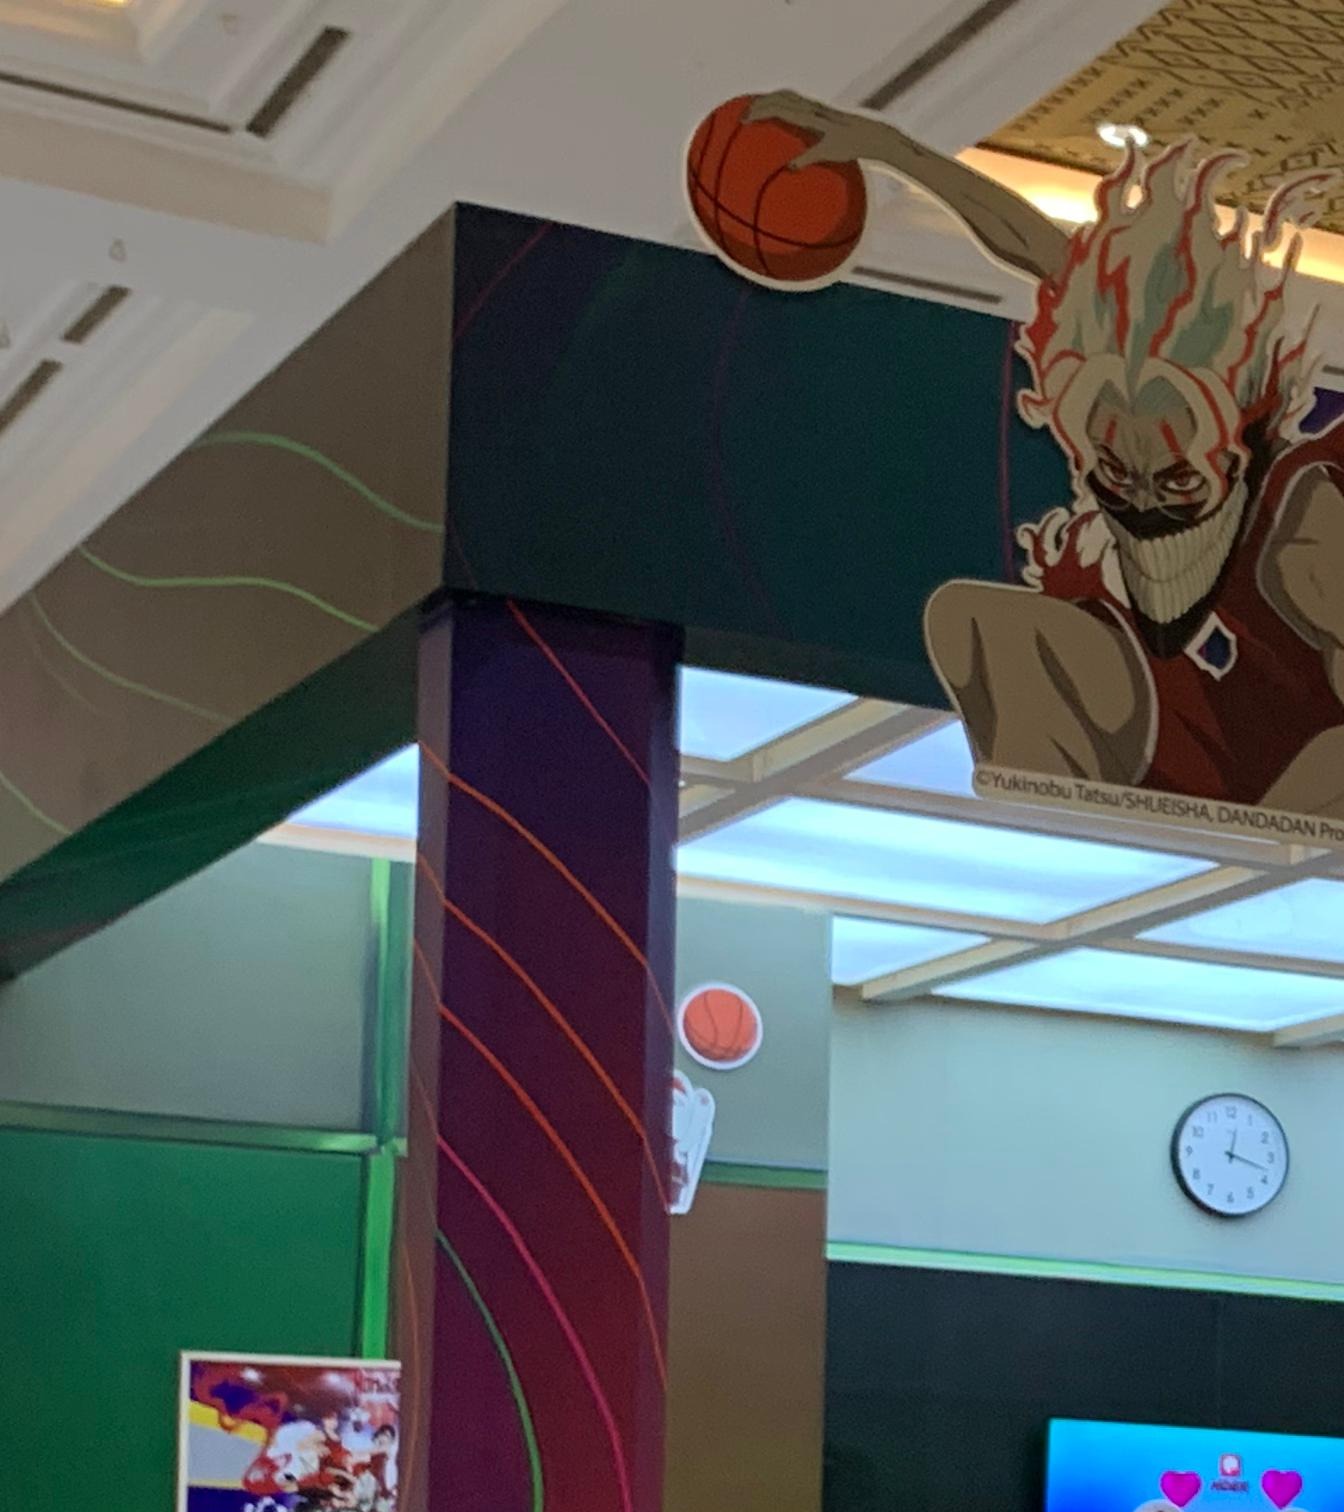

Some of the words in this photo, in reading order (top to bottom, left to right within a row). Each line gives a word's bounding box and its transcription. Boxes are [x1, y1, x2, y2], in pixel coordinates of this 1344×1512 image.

[976, 770, 1072, 800] ©Yukinobu
[1075, 784, 1213, 822] Tatsu/SHUEISHA,
[1218, 806, 1316, 837] DANDADAN
[1207, 1111, 1218, 1122] 11
[1225, 1106, 1237, 1118] 12
[1247, 1114, 1253, 1126] 1
[1192, 1126, 1204, 1138] 10
[1261, 1131, 1269, 1144] 2
[1185, 1146, 1193, 1157] 9
[1267, 1152, 1275, 1163] 3
[1192, 1168, 1201, 1180] 8
[1260, 1175, 1268, 1185] 4
[1207, 1183, 1215, 1195] 7
[1246, 1187, 1254, 1199] 5
[1226, 1192, 1235, 1203] 6
